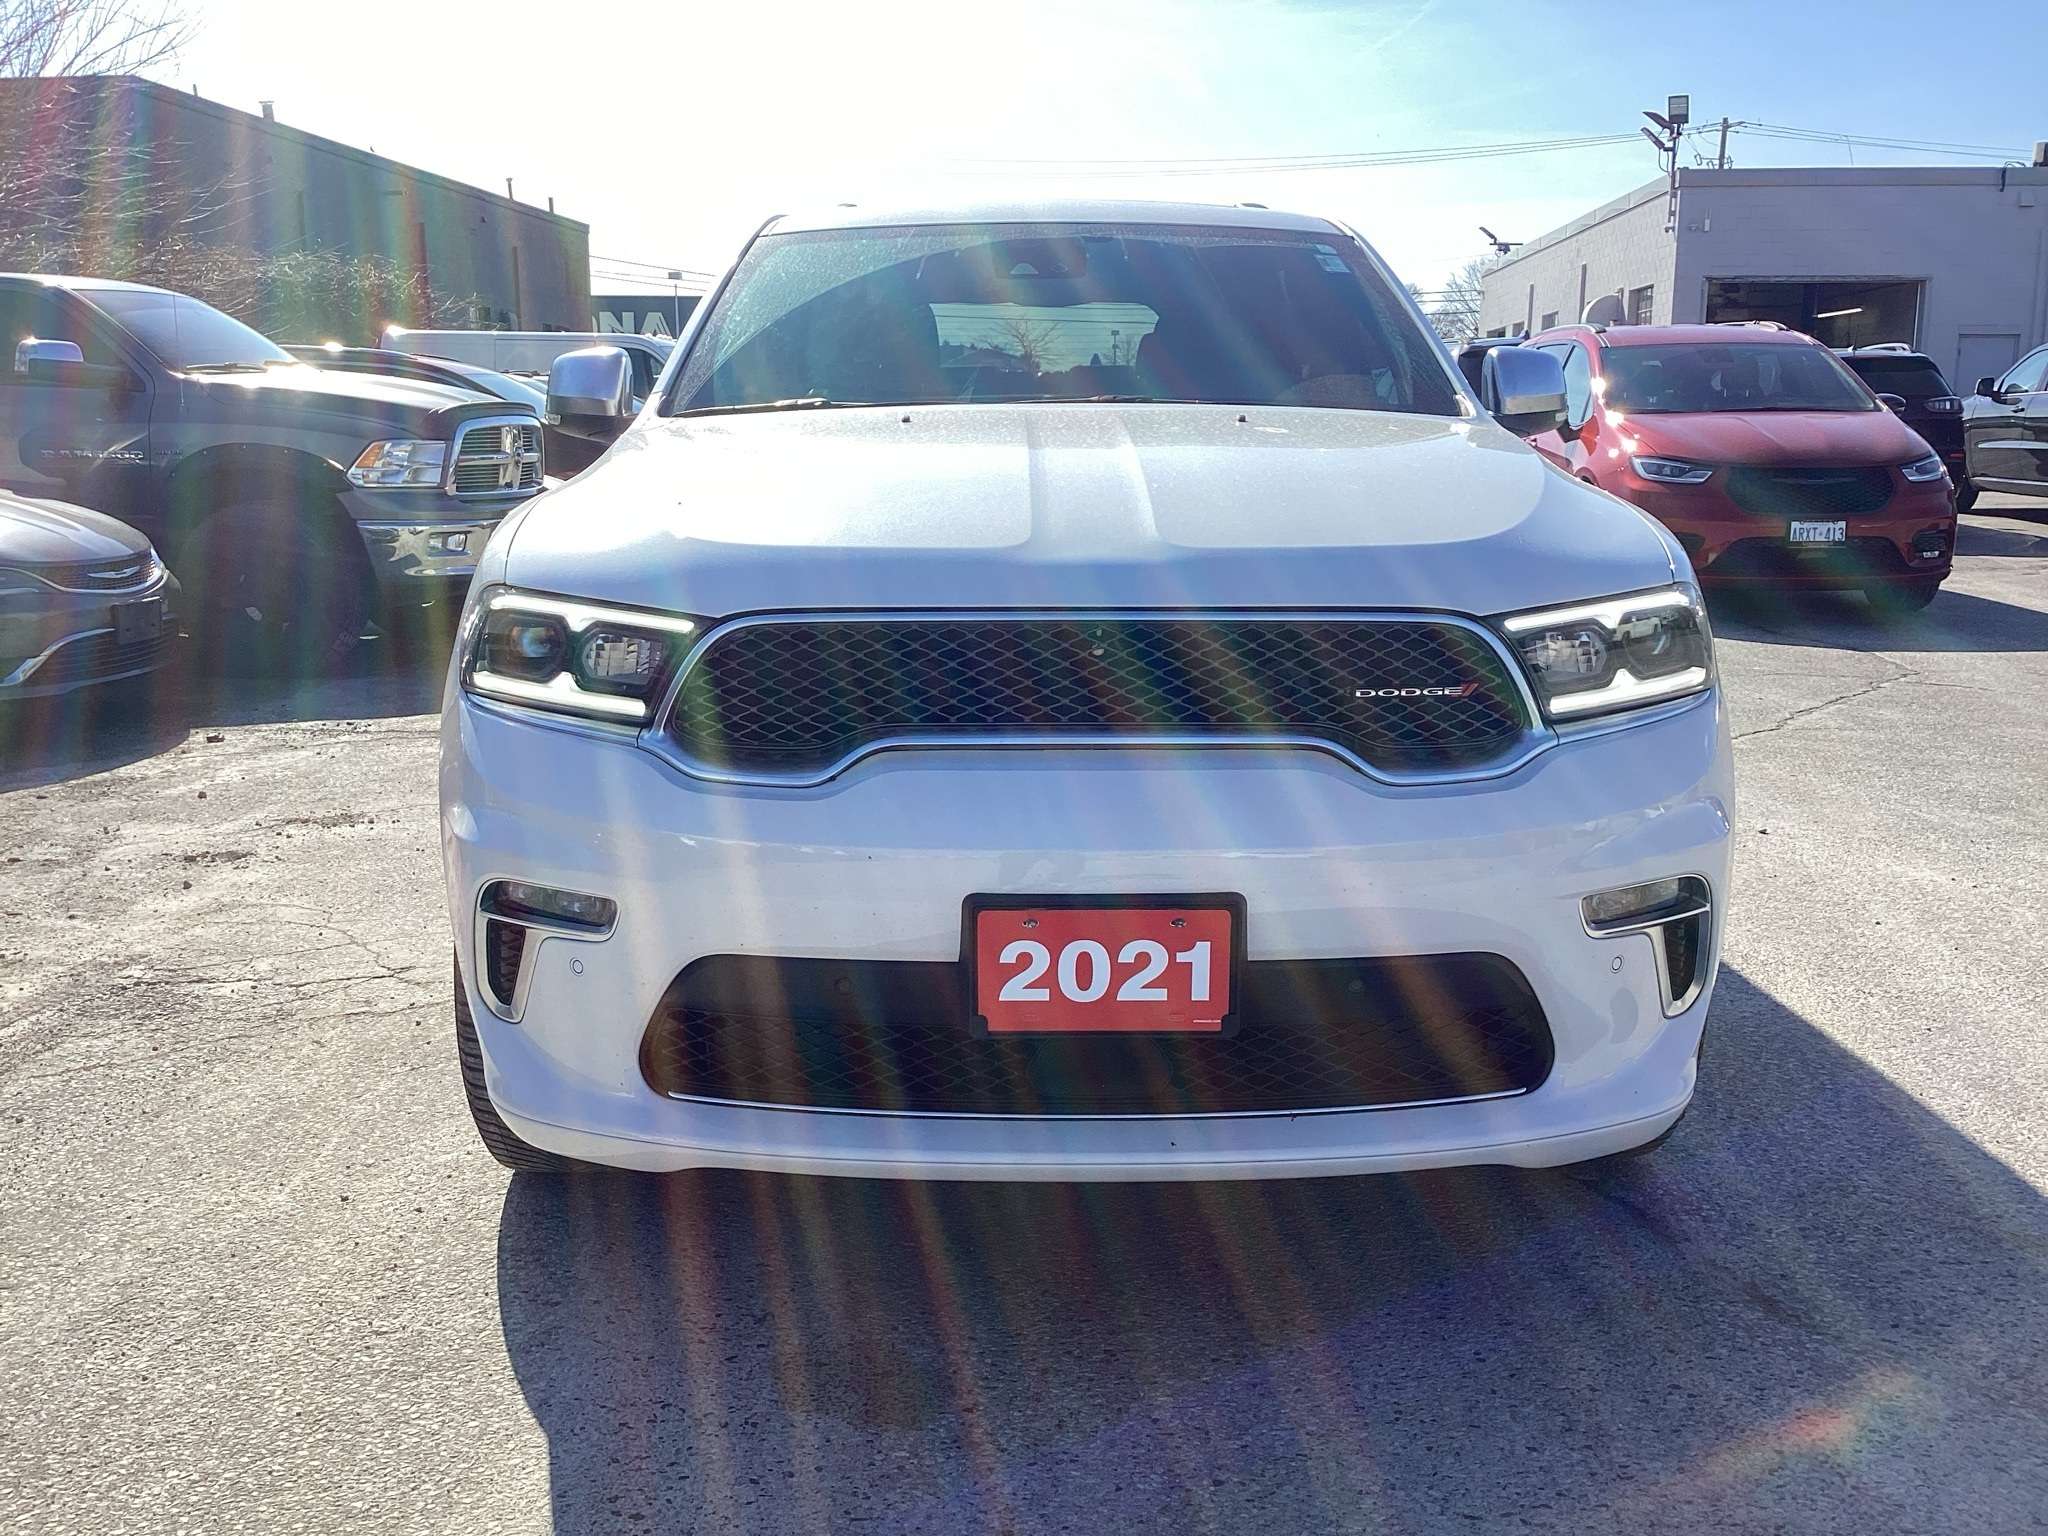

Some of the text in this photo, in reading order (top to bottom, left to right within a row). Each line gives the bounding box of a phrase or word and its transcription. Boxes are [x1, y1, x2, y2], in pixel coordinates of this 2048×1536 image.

[592, 312, 672, 339] NA
[1355, 686, 1463, 698] DODGE
[998, 939, 1212, 1003] 2021
